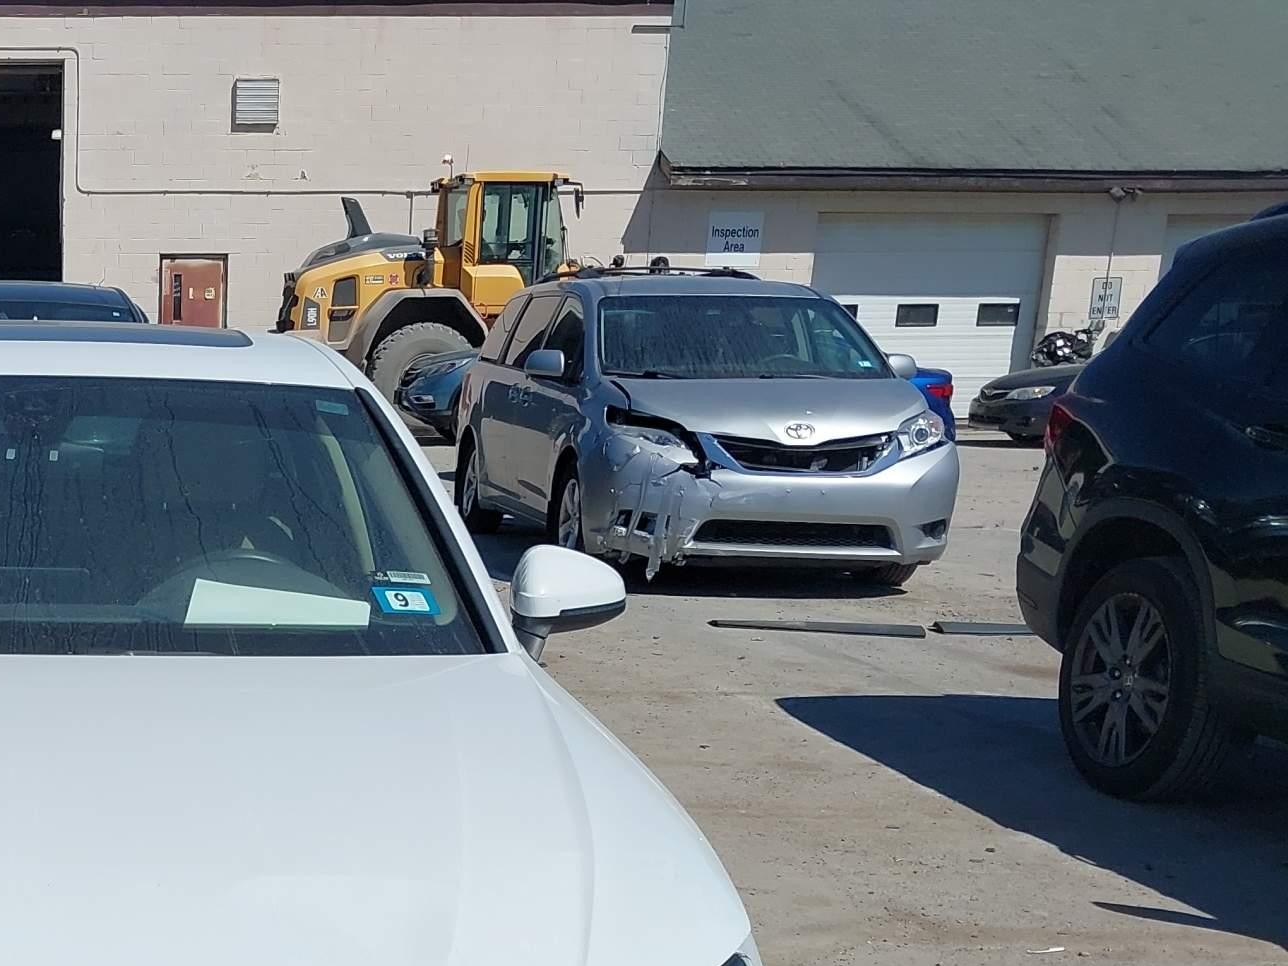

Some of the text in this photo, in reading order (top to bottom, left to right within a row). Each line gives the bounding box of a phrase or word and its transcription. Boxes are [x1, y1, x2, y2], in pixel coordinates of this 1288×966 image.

[711, 225, 760, 241] Inspection
[723, 240, 745, 253] Area
[1098, 294, 1113, 302] NT
[1092, 306, 1117, 315] ENER
[393, 592, 410, 608] 9
